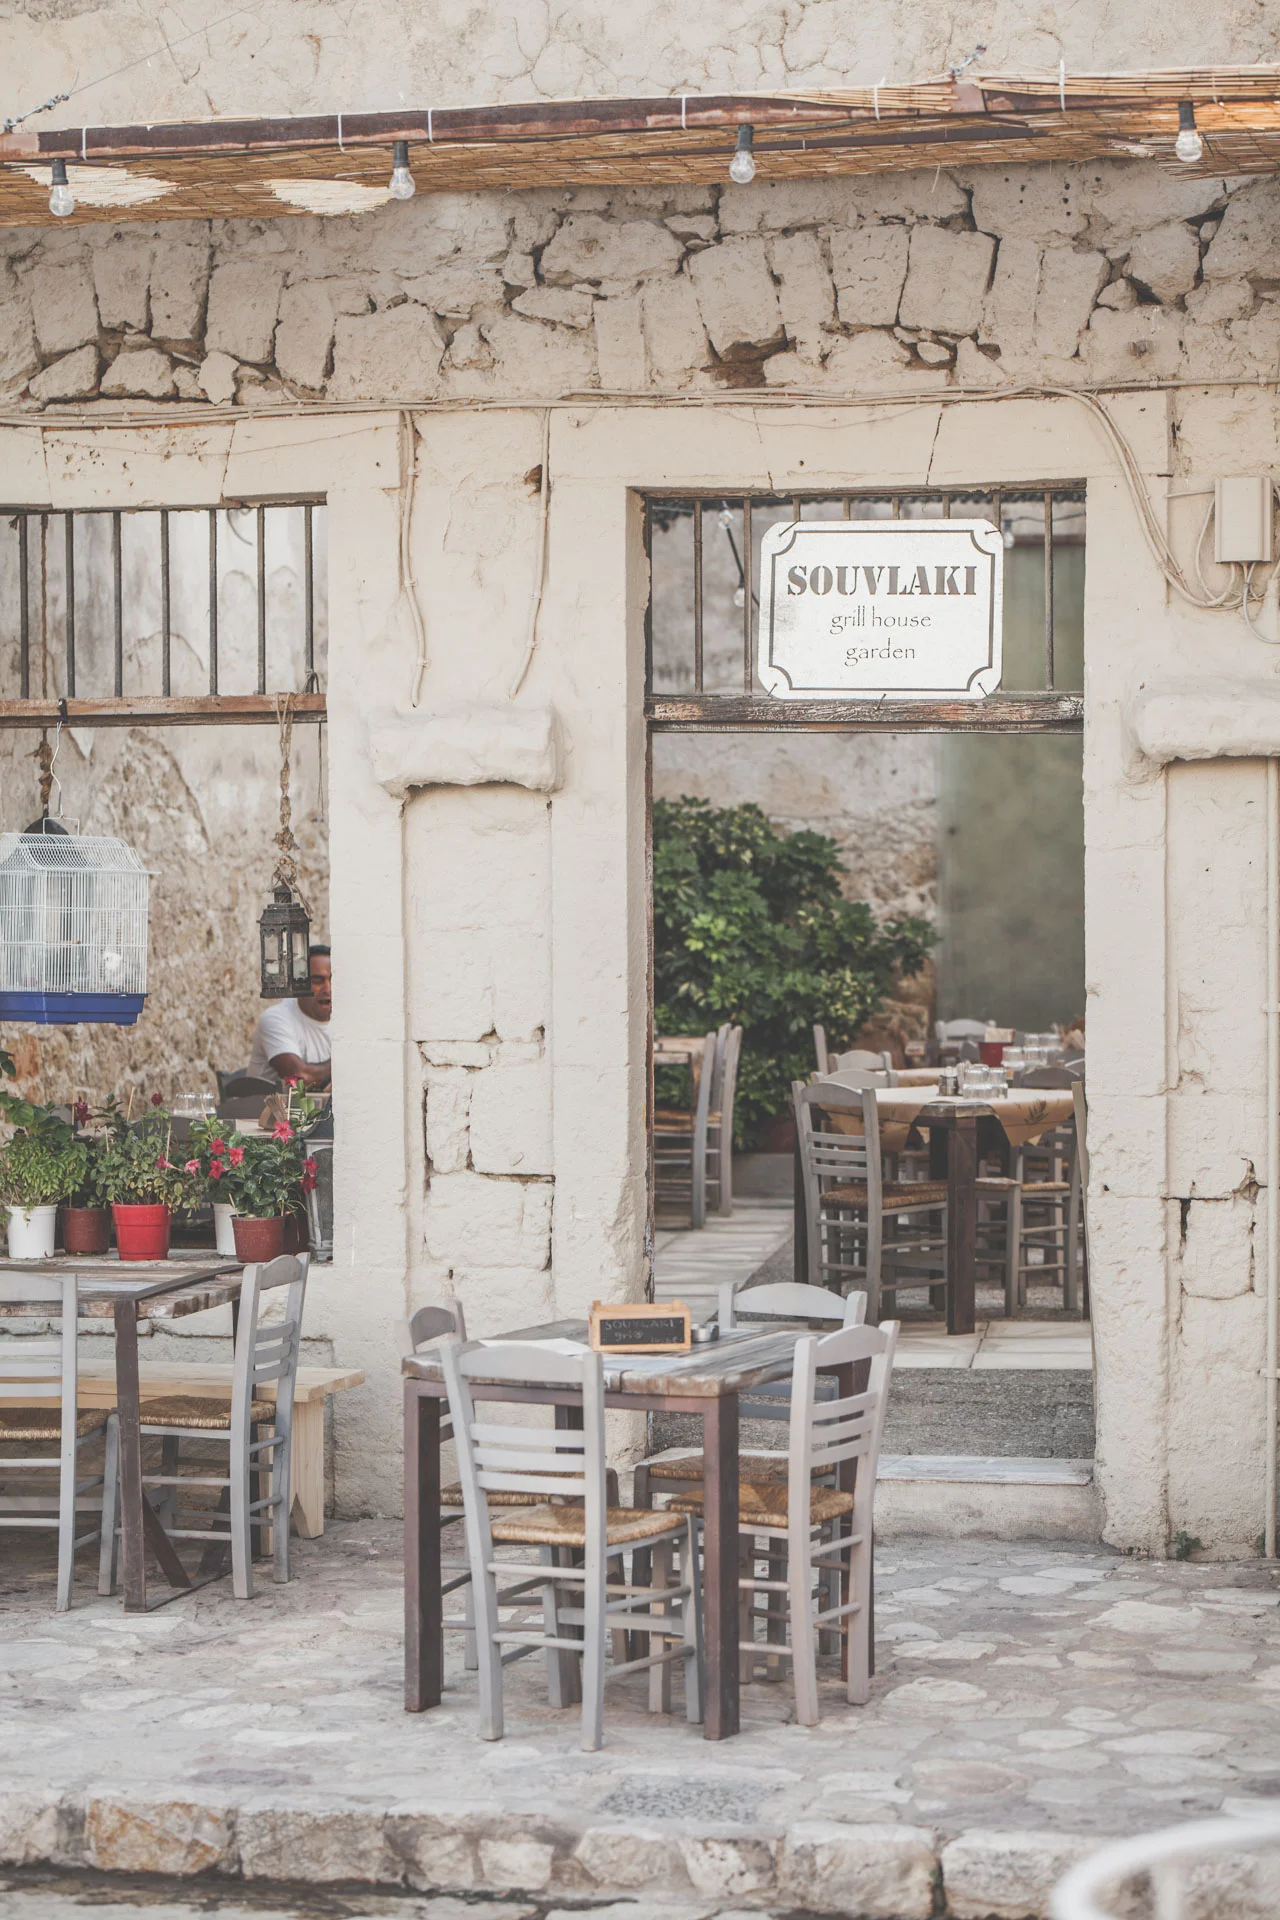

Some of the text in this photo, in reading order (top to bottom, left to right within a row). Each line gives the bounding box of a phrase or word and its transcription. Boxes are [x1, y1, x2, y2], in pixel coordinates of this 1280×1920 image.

[787, 565, 978, 596] SOUVLAKI
[829, 605, 932, 635] grill house
[844, 637, 916, 667] garden
